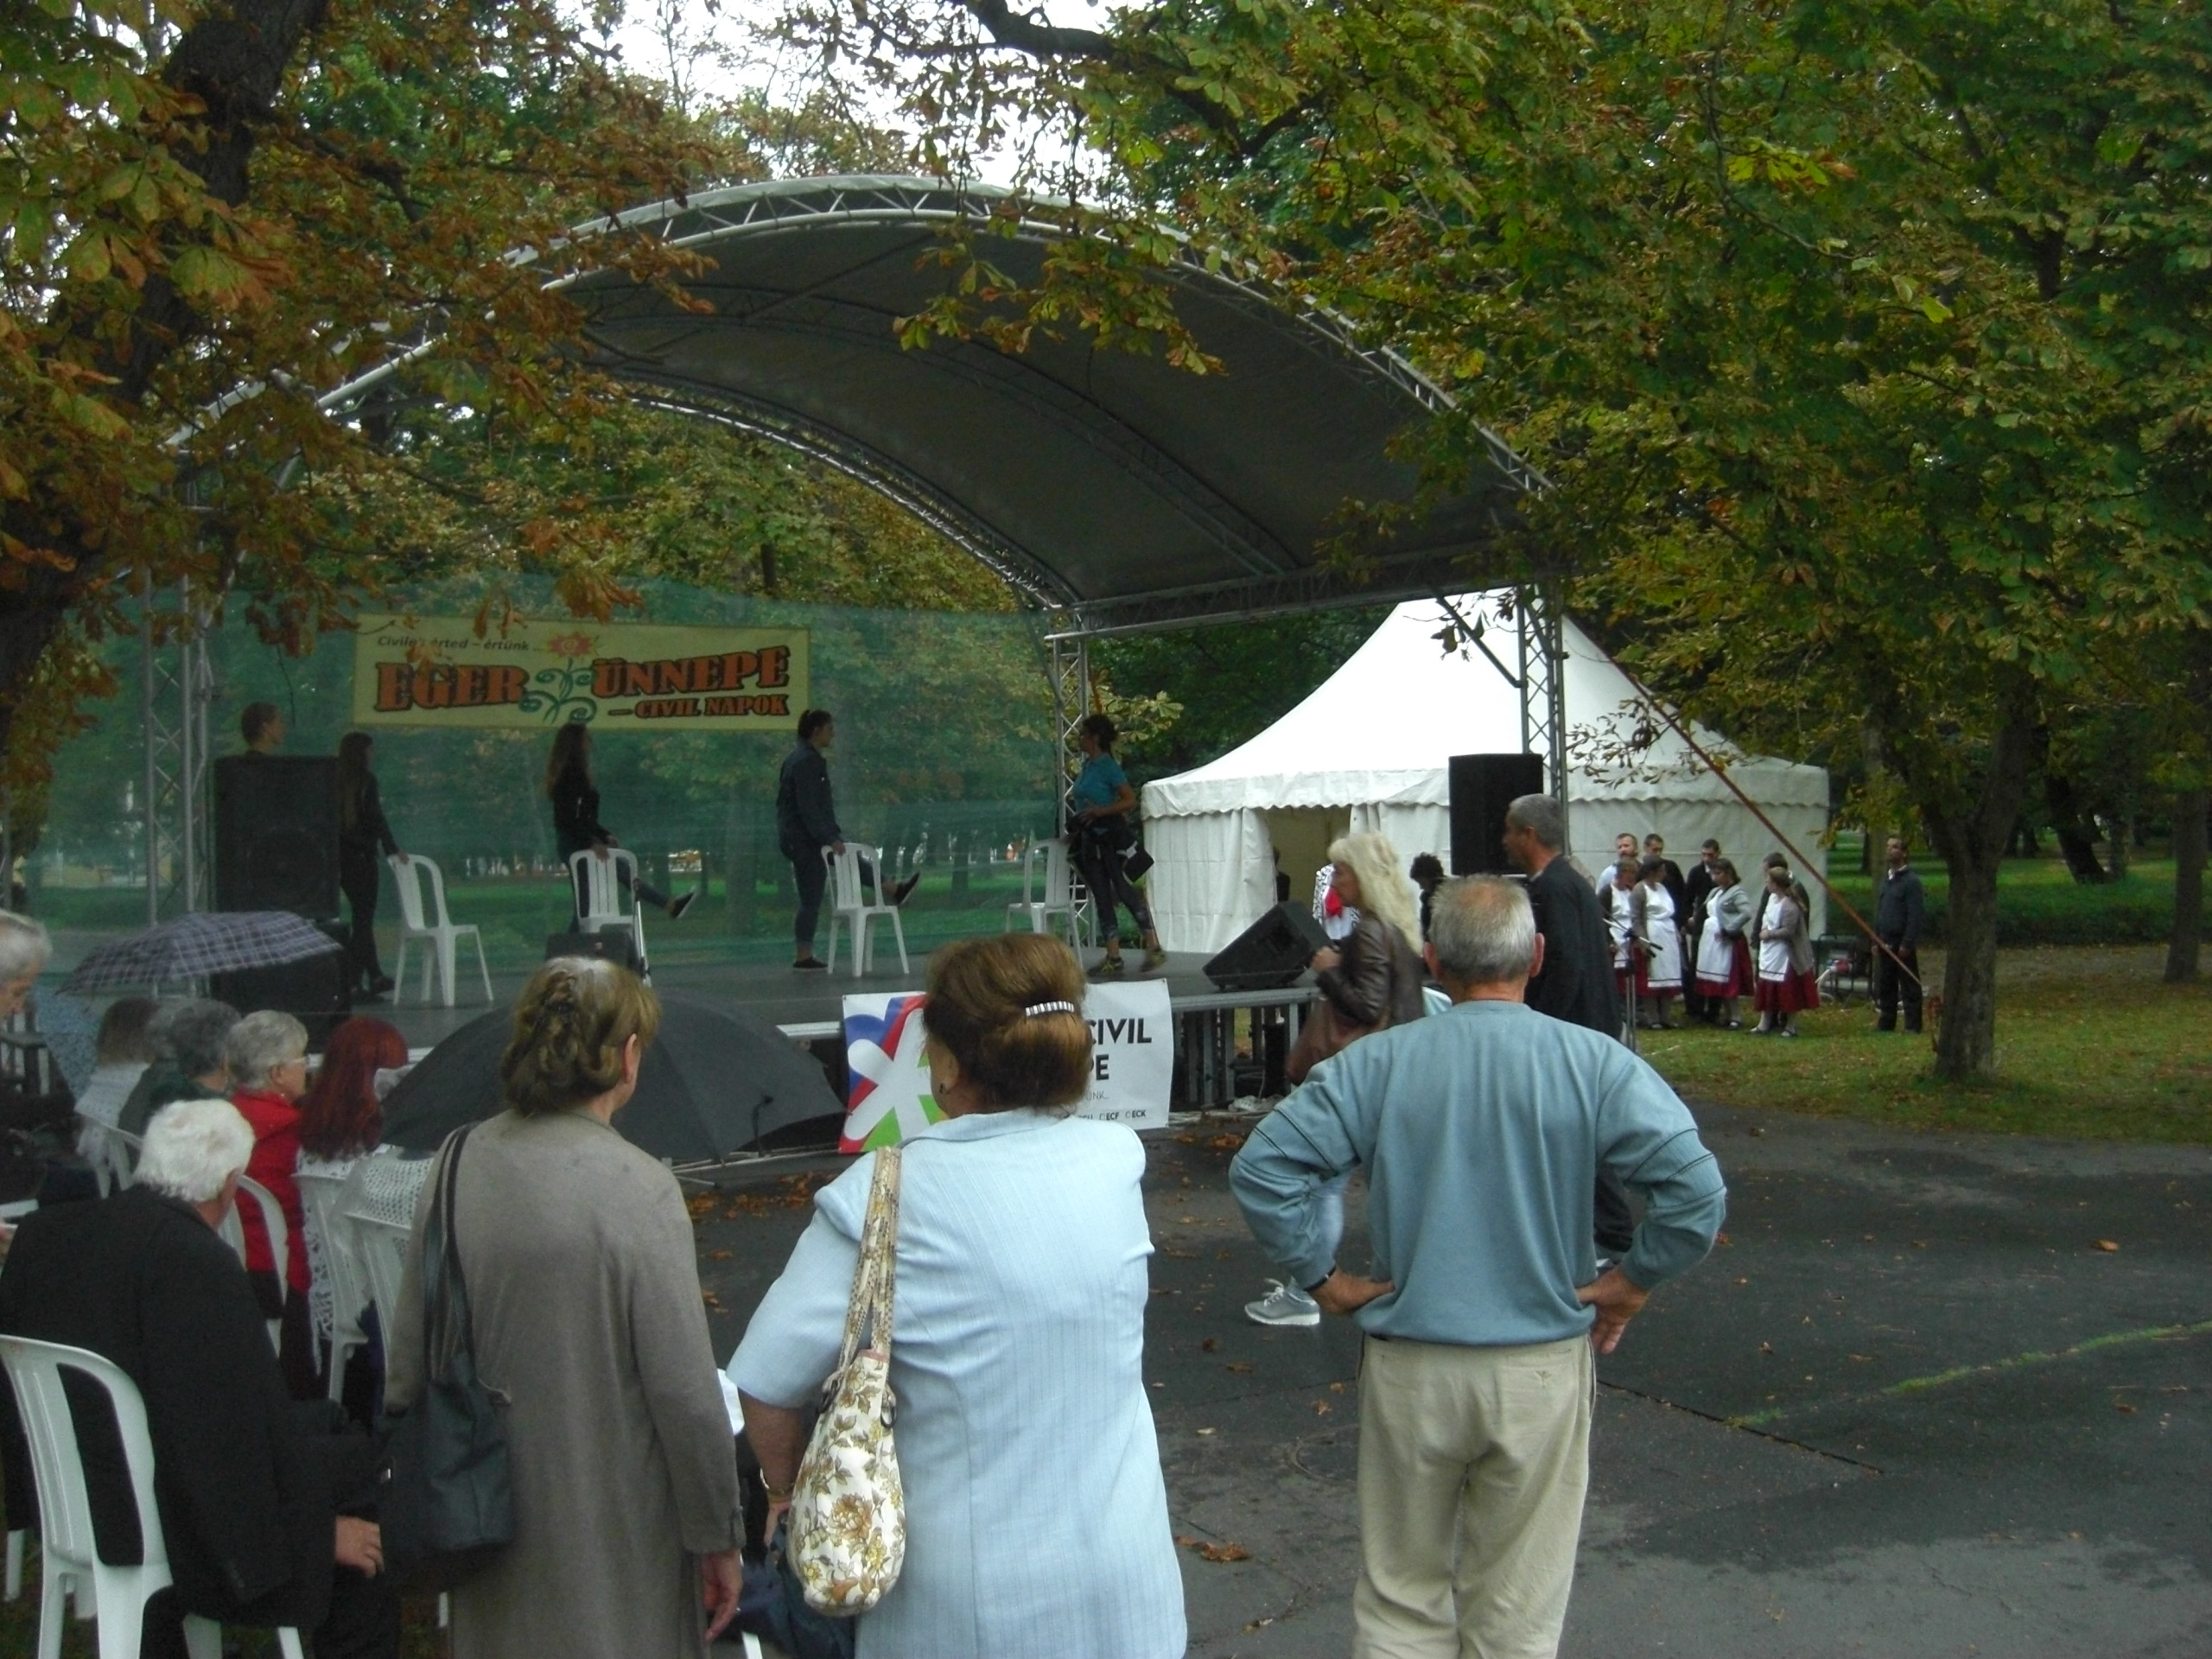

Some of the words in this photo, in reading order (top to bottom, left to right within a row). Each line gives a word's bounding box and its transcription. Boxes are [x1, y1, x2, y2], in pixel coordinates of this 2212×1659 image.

[373, 662, 534, 712] EGER
[635, 697, 702, 719] CIVIL
[703, 694, 791, 716] NAPOK
